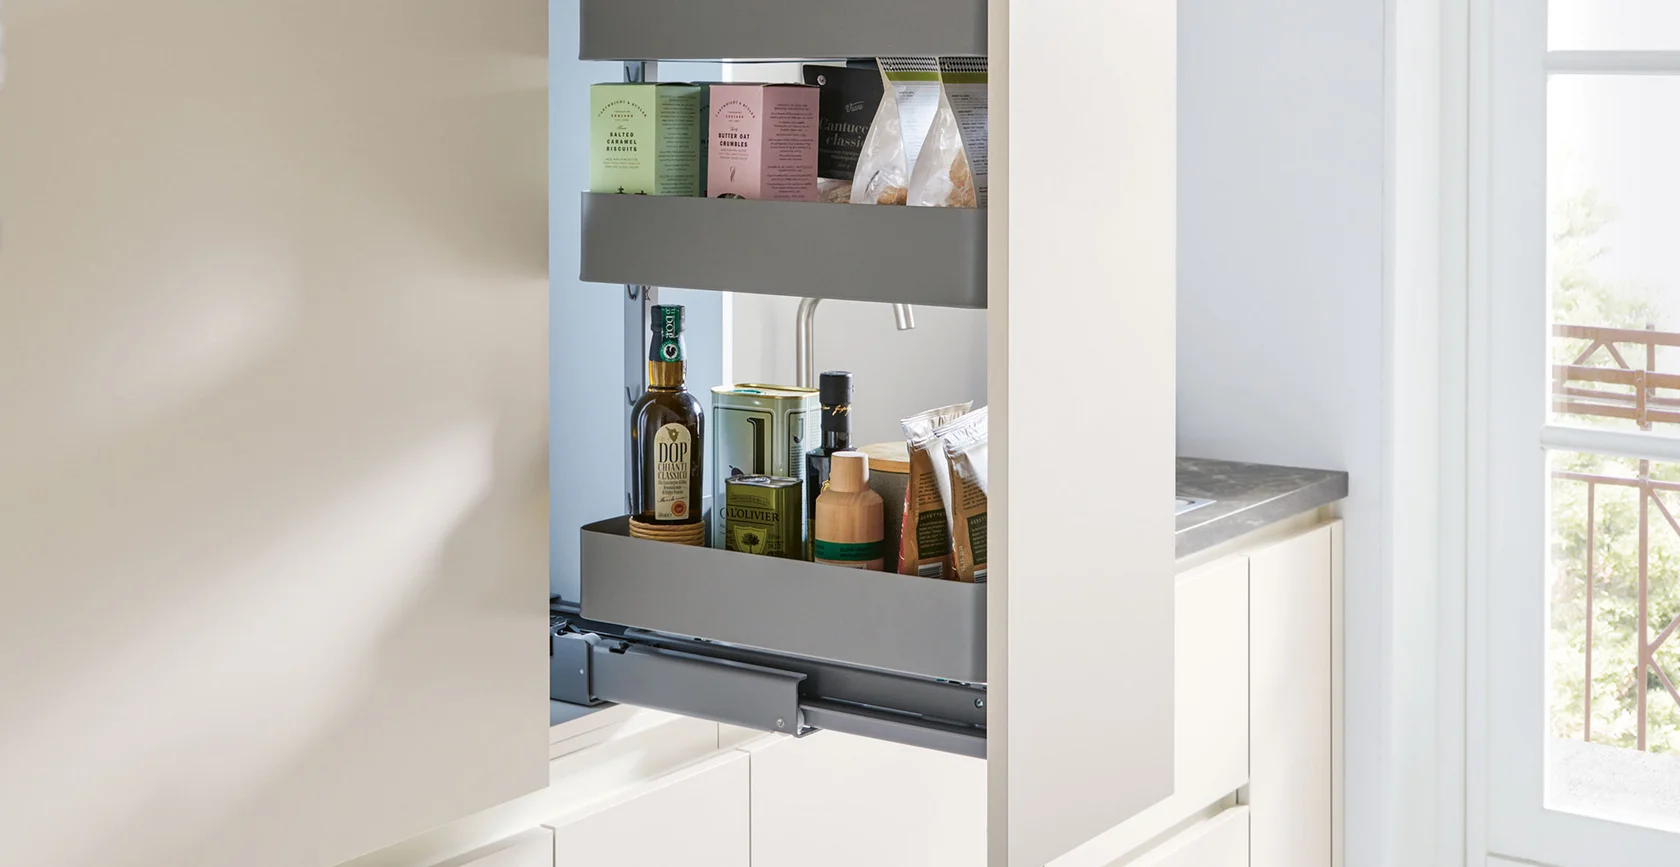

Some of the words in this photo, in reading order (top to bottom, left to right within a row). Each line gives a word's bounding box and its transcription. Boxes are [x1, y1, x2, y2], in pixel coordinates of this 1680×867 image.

[820, 118, 872, 134] Cantucc
[719, 140, 748, 148] CRUMBLES
[659, 441, 688, 463] DOP
[657, 463, 688, 471] CHIANTI
[657, 471, 688, 480] CLASSICO
[730, 507, 780, 522] L'OLIVIER
